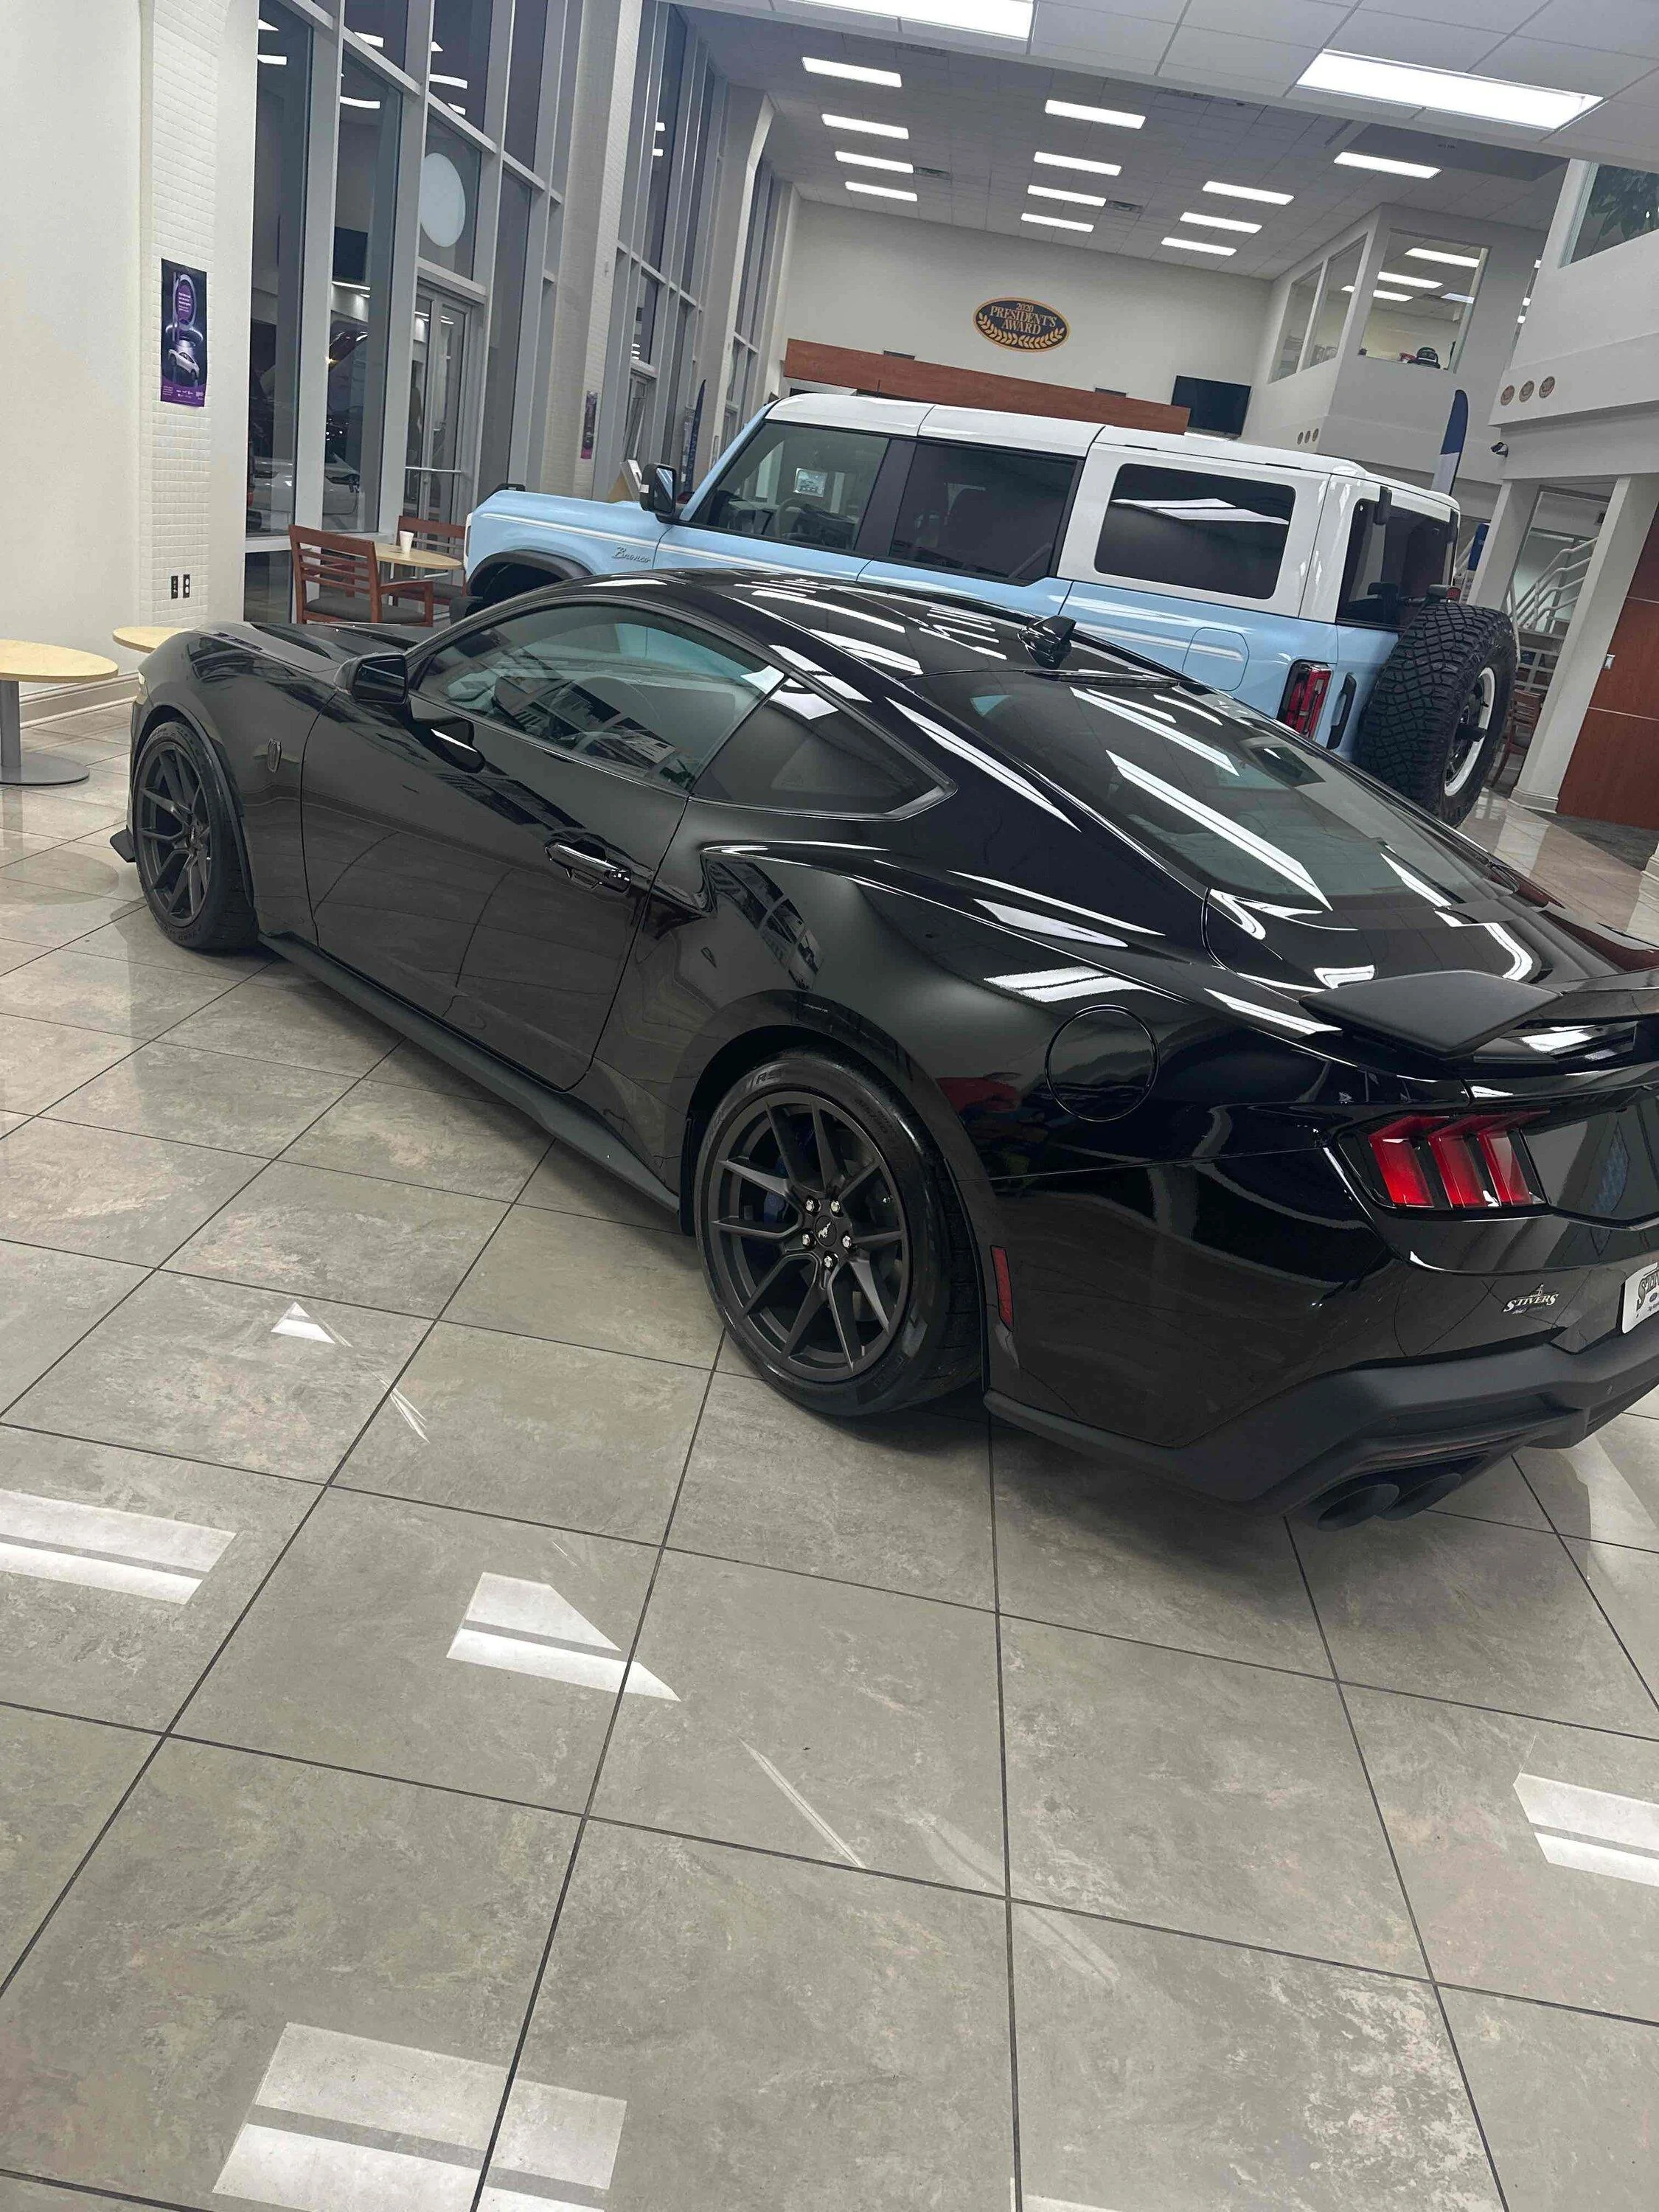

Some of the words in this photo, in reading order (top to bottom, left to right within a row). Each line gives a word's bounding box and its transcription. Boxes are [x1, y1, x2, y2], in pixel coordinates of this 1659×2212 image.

[990, 305, 1057, 327] PRESIDENT'S
[1001, 319, 1041, 335] AWARD
[611, 546, 651, 563] Bronco
[1503, 1293, 1559, 1312] STIVERS
